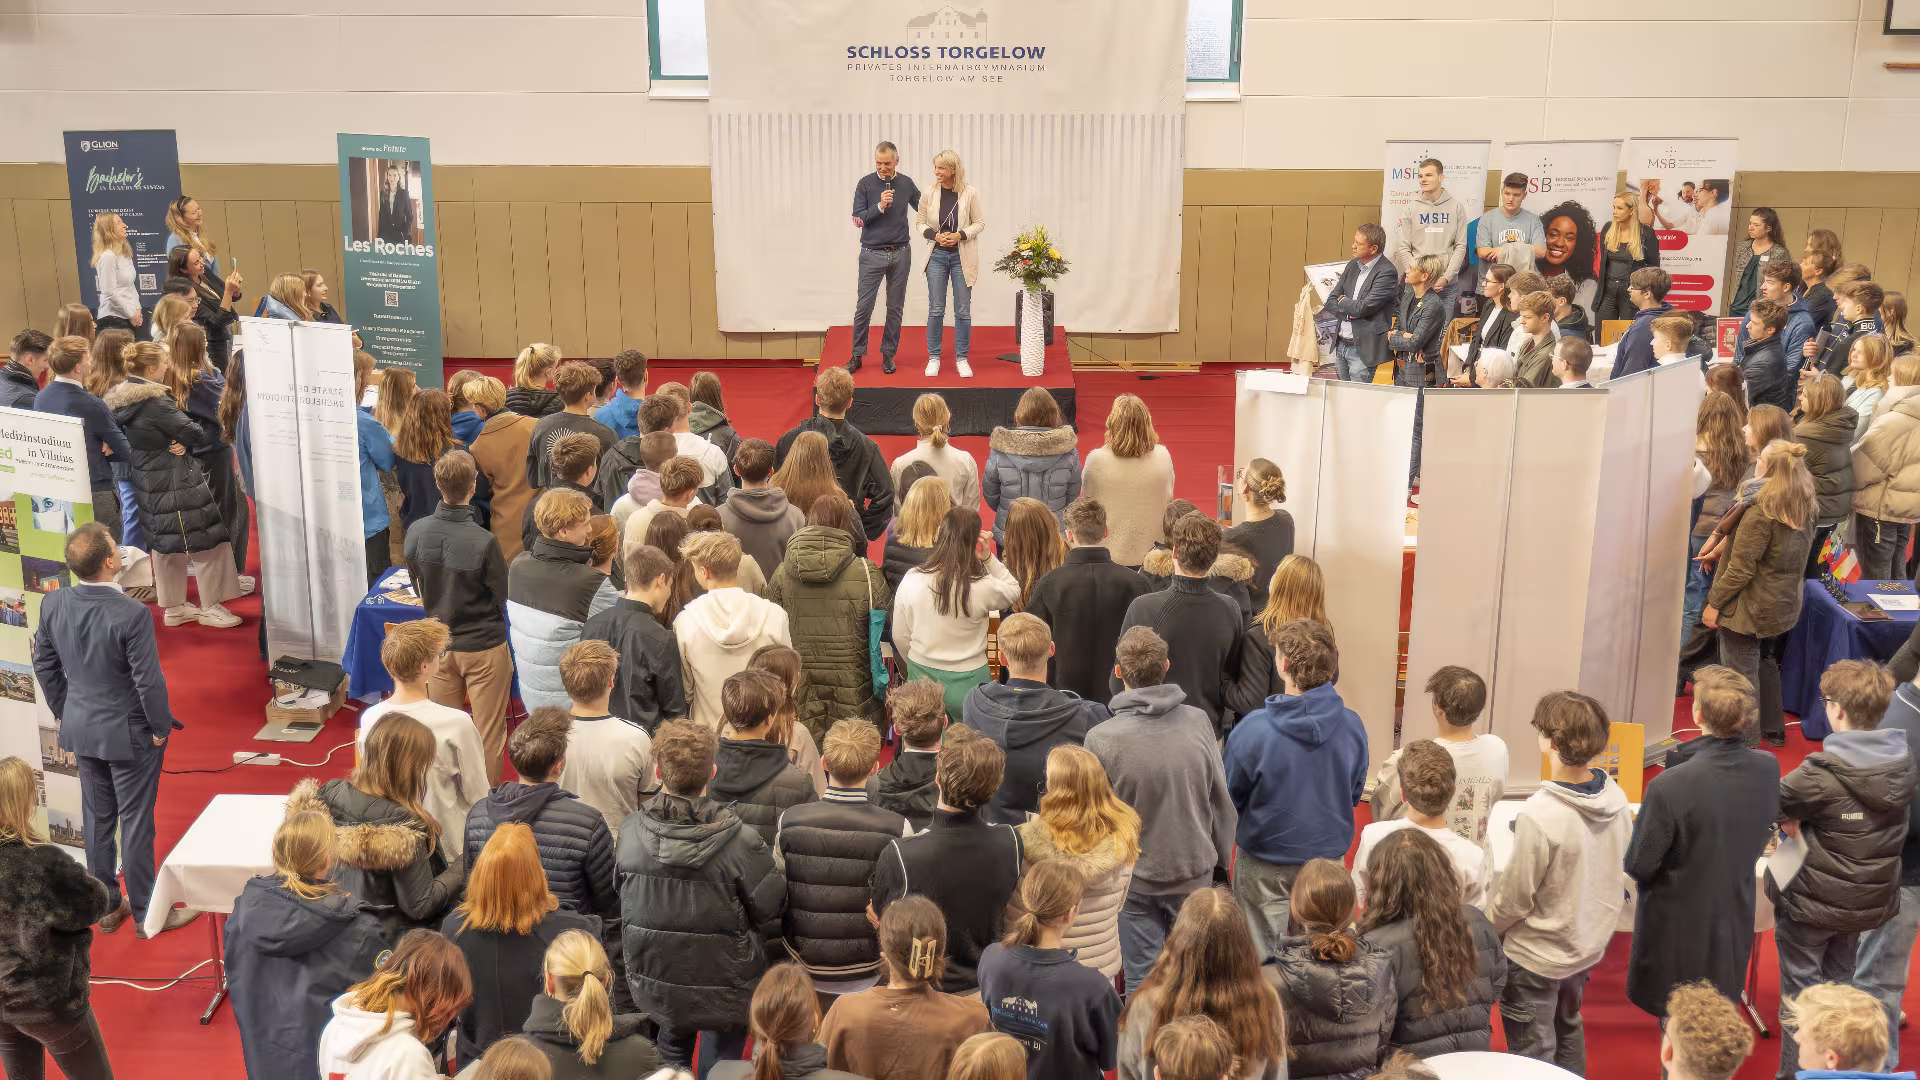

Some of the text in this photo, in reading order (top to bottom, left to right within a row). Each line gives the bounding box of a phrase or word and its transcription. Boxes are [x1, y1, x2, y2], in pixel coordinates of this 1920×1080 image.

[847, 46, 1046, 58] SCHLOSS TORGELOW
[92, 140, 118, 148] GLION
[1648, 158, 1676, 169] MSB
[1528, 177, 1552, 193] SB
[1419, 213, 1449, 224] MSH
[344, 235, 434, 257] Les Roches
[28, 447, 74, 464] in Vilnius
